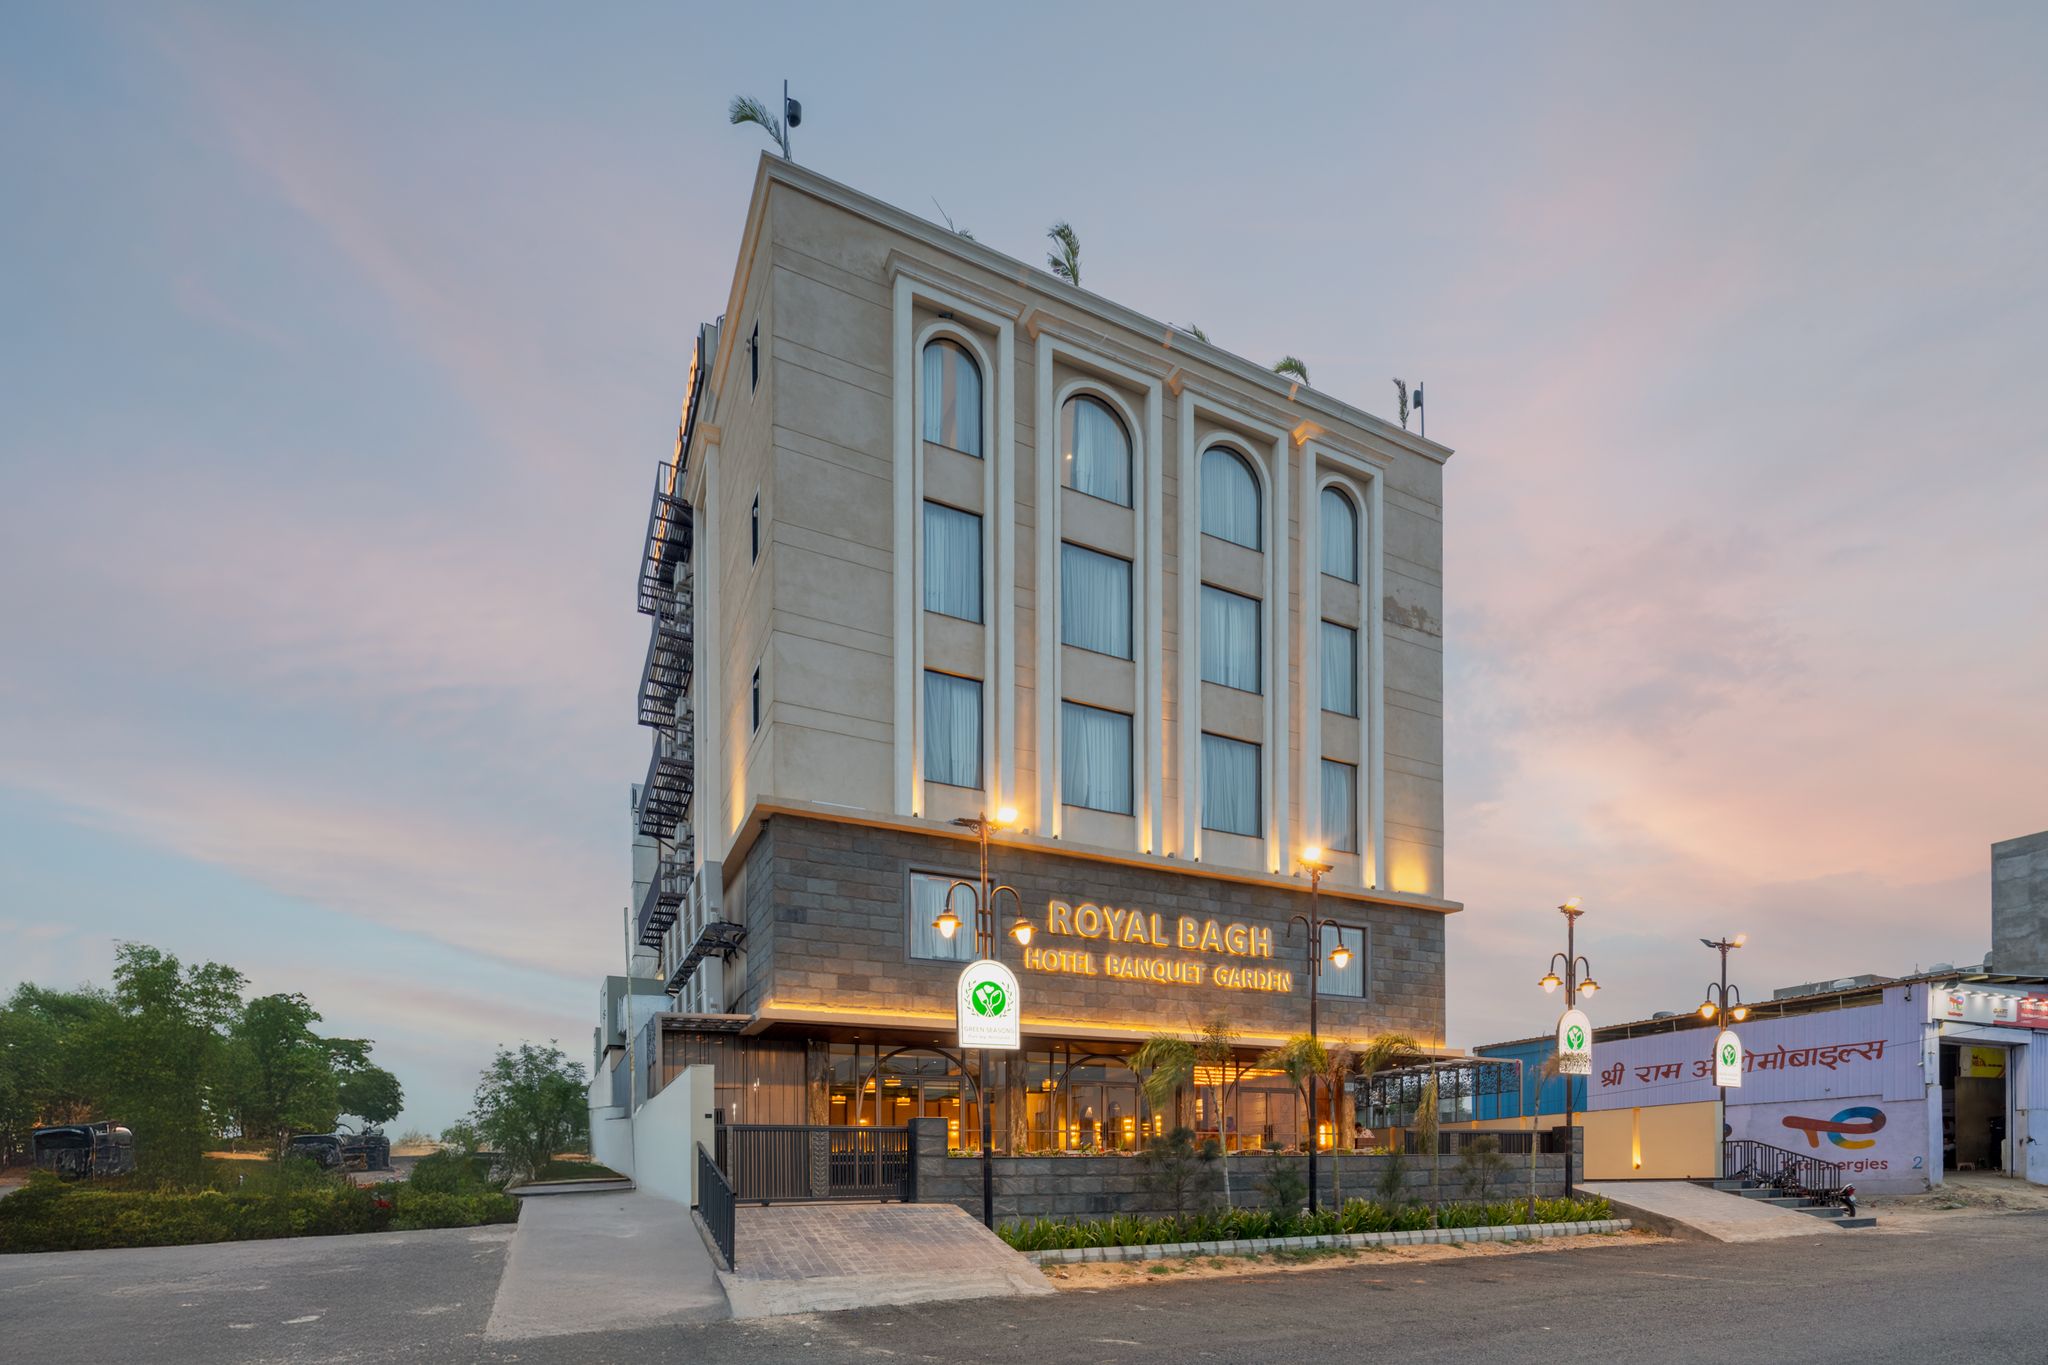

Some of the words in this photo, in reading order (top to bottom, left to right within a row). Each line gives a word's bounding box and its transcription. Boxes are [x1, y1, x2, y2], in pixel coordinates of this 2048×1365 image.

[1049, 900, 1169, 947] ROYAL
[1178, 916, 1274, 957] BAGH
[1024, 948, 1097, 975] HOTEL
[1106, 954, 1206, 985] BANQUET
[1214, 966, 1293, 992] GARDEN
[1600, 1061, 1625, 1088] श्री
[1634, 1062, 1684, 1083] राम
[1912, 1156, 1923, 1170] 2
